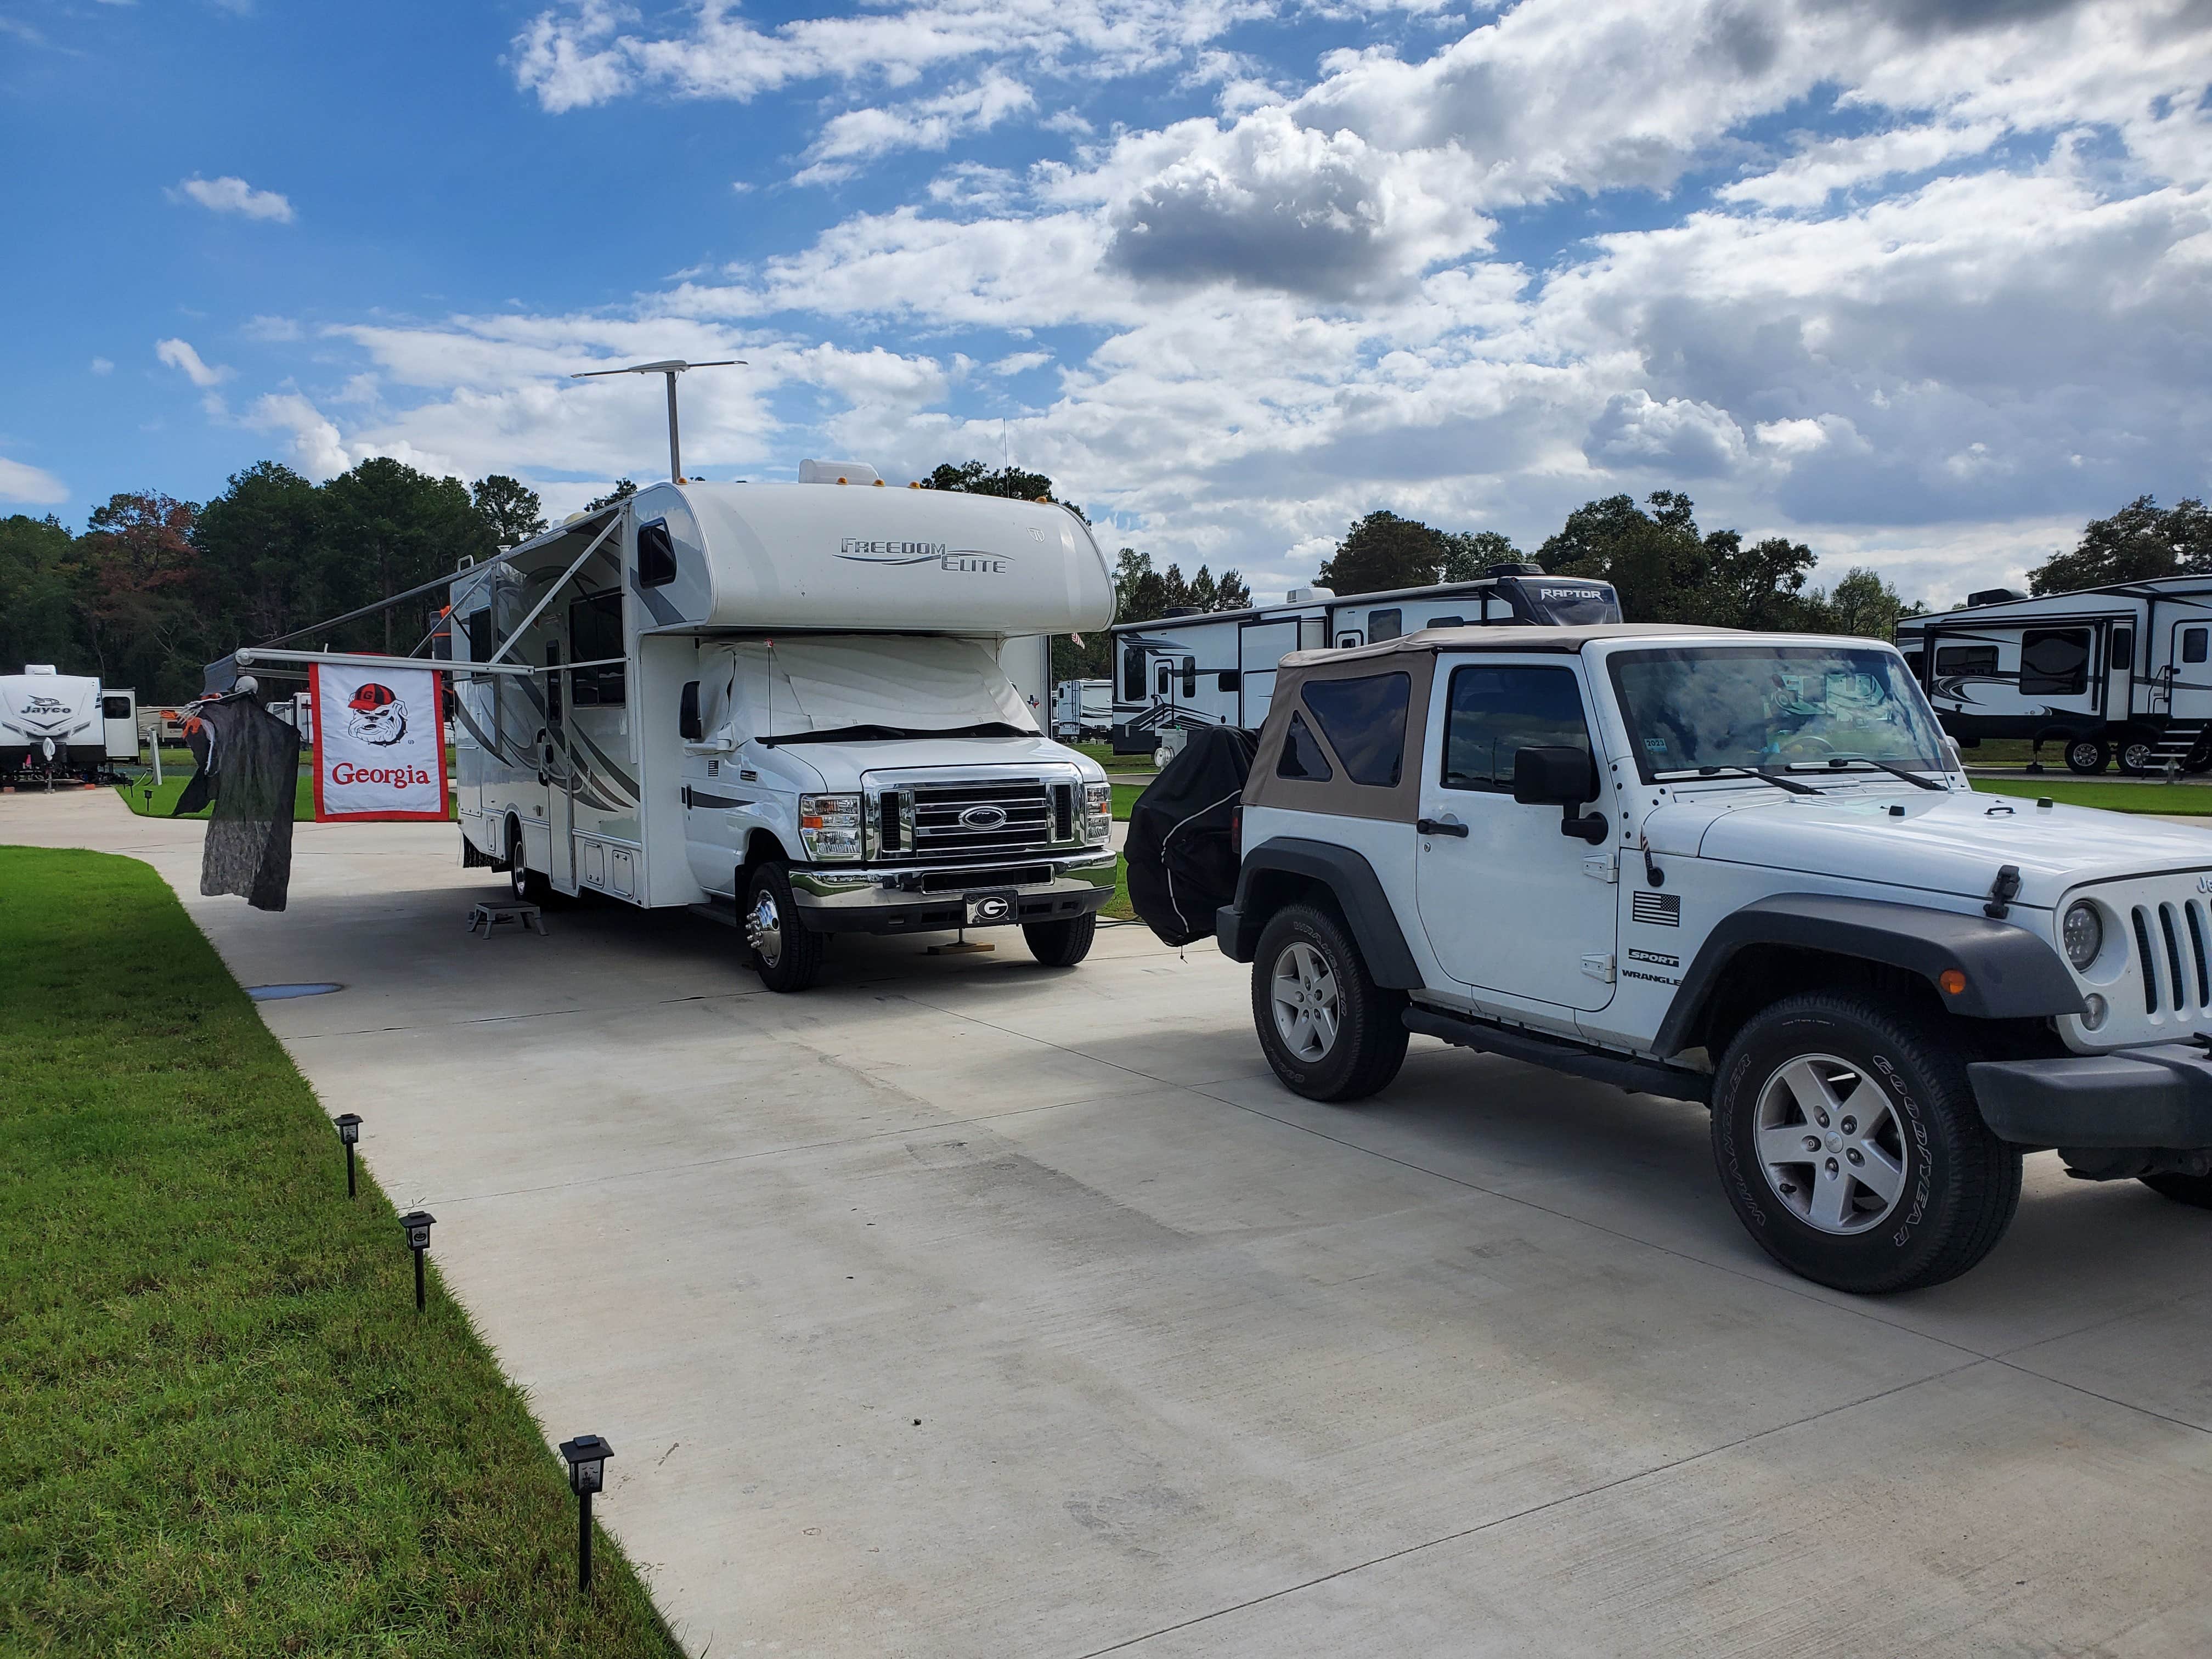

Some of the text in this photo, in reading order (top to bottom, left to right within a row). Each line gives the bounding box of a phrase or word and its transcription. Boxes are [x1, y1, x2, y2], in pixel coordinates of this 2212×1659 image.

[841, 538, 946, 555] FREEDOM
[941, 555, 1006, 574] ELITE
[1541, 588, 1605, 603] RAPTOR
[21, 706, 72, 715] Jayco
[332, 762, 431, 789] Georgia
[975, 896, 1008, 919] G
[1629, 951, 1679, 965] SPORT
[1622, 969, 1682, 986] WRANGLE
[1723, 1053, 1766, 1227] WRANGLER
[1873, 1055, 1932, 1247] GOODYEAR
